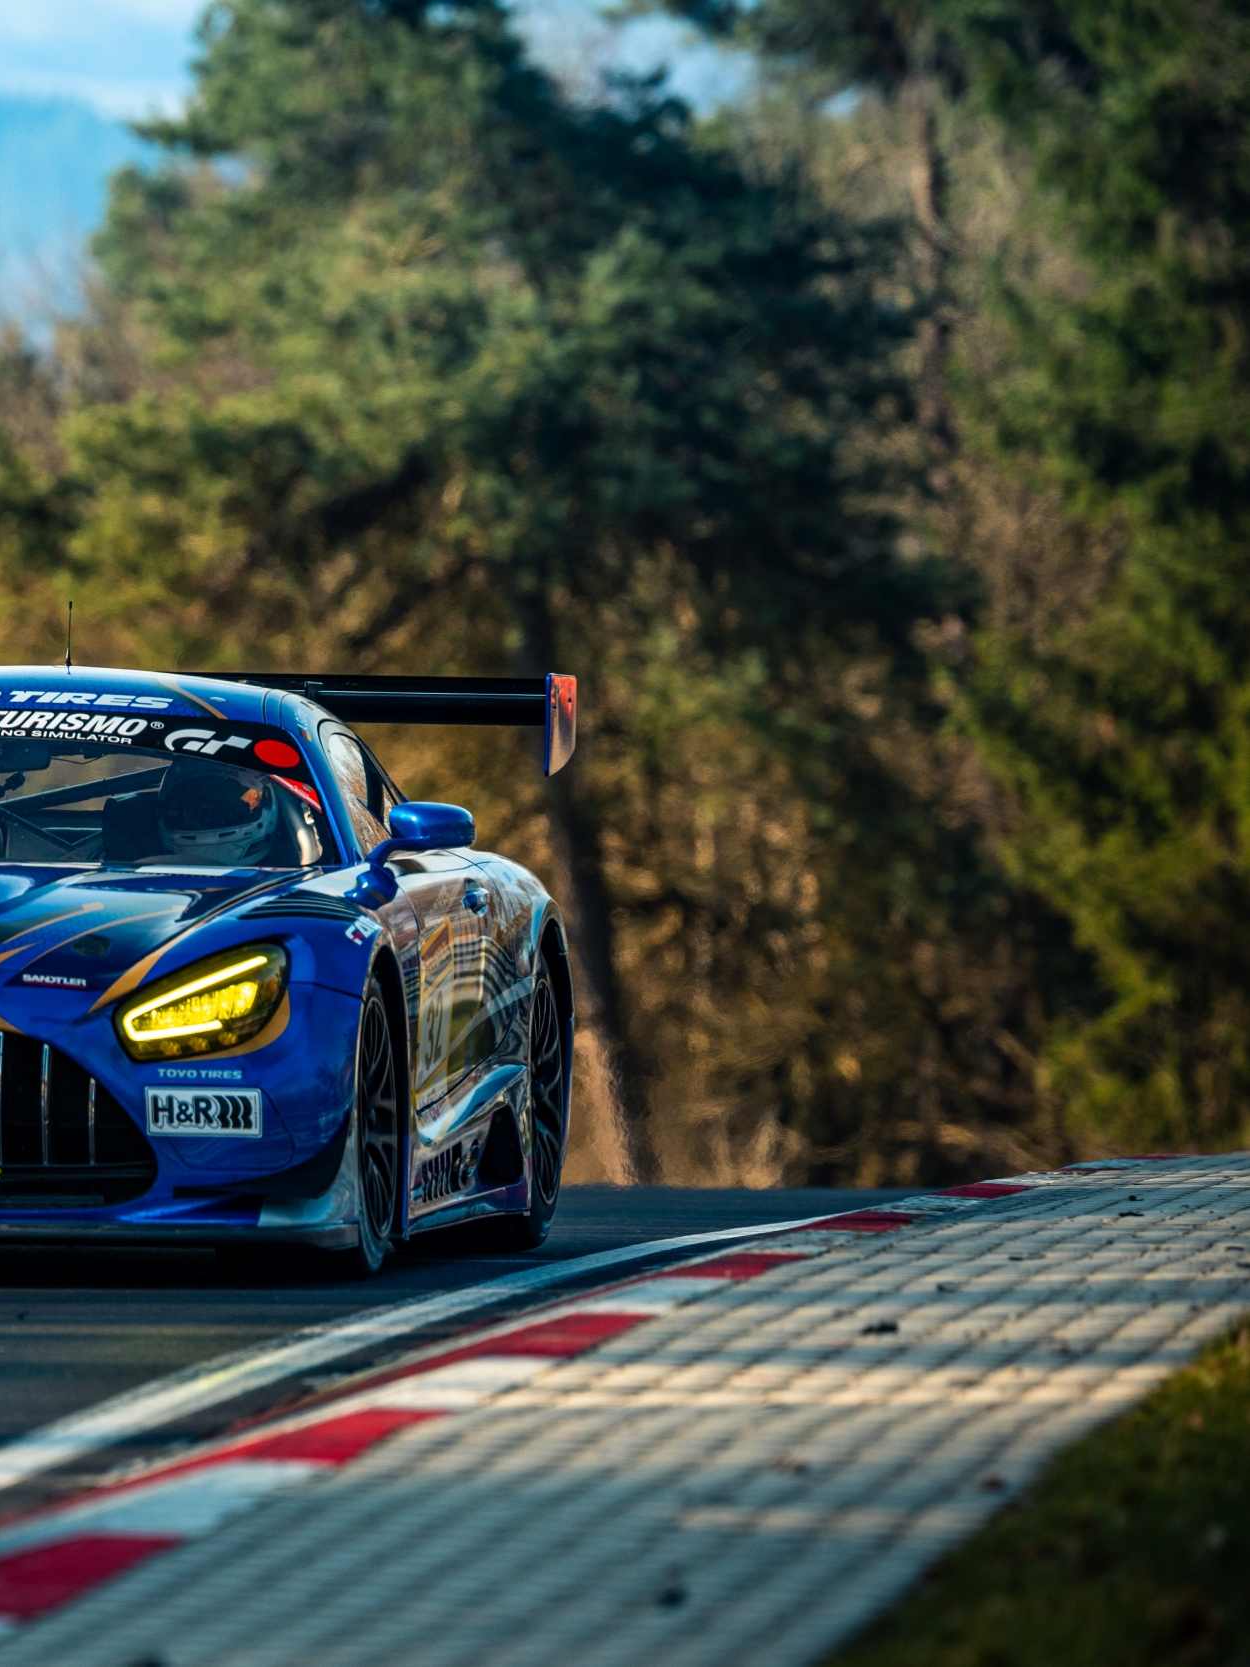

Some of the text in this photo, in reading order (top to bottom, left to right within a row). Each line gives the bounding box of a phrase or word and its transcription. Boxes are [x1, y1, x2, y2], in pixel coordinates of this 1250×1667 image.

[8, 690, 174, 709] TIRES
[30, 729, 133, 745] SIMULATOR
[157, 1068, 243, 1080] TOYO TIRES
[150, 1094, 217, 1129] H&R
